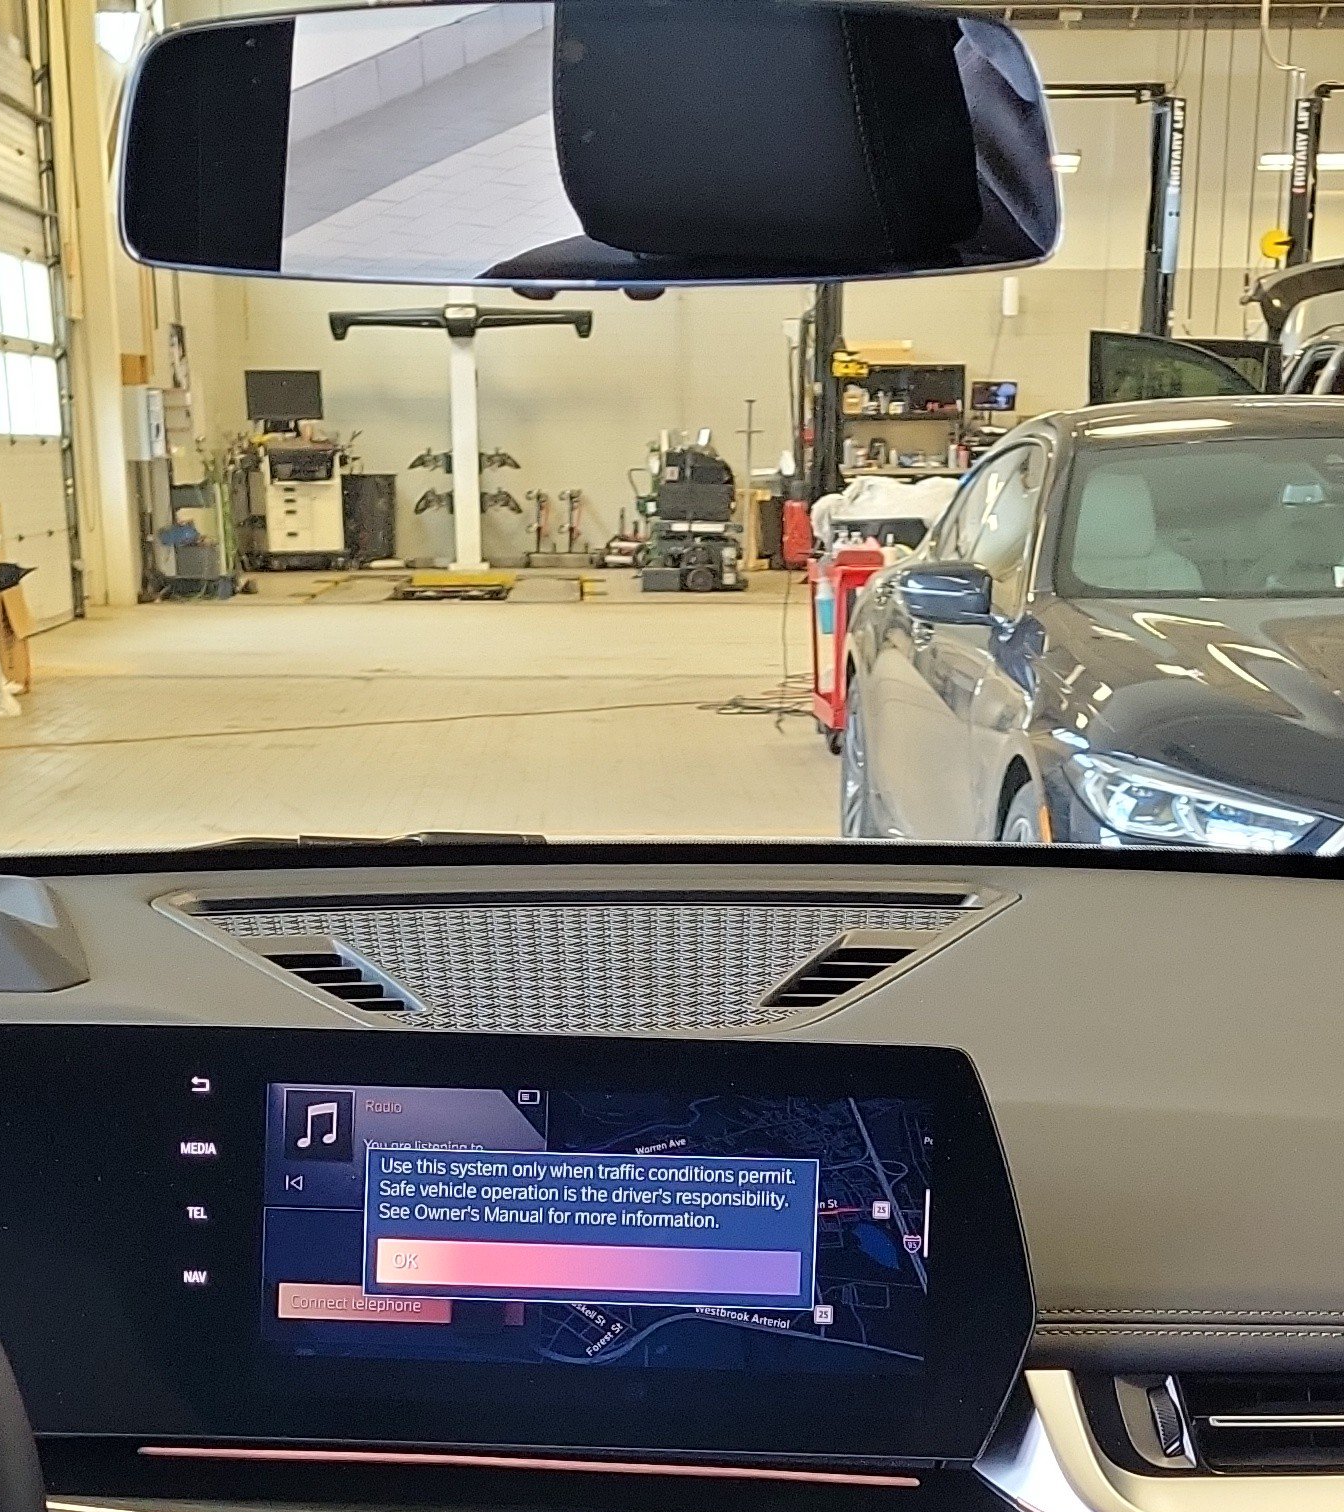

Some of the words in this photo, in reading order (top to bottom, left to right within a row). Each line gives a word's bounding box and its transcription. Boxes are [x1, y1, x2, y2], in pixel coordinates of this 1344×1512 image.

[1173, 100, 1185, 129] LIFT
[1297, 100, 1310, 129] LIFT
[1169, 131, 1183, 186] ROTARY
[1293, 132, 1308, 186] ROTARY
[365, 1100, 402, 1113] Radio
[180, 1142, 217, 1155] MEDIA
[363, 1139, 387, 1149] You
[635, 1143, 667, 1155] Warren
[669, 1137, 686, 1148] Ave
[381, 1158, 412, 1174] Use
[417, 1159, 446, 1175] this
[450, 1162, 507, 1179] system
[512, 1162, 546, 1180] only
[550, 1164, 593, 1179] when
[598, 1165, 645, 1180] traffic
[649, 1166, 734, 1183] conditions
[739, 1168, 795, 1186] permit.
[379, 1180, 415, 1197] Safe
[420, 1182, 476, 1198] vehicle
[481, 1185, 558, 1202] operation
[564, 1186, 576, 1201] is
[581, 1187, 607, 1202] the
[612, 1188, 671, 1204] driver's
[676, 1191, 789, 1210] responsibility.
[827, 1199, 838, 1208] St
[187, 1206, 207, 1219] TEL
[379, 1203, 410, 1219] See
[415, 1204, 480, 1221] Owner's
[484, 1207, 543, 1223] Manual
[548, 1208, 571, 1224] for
[575, 1213, 616, 1225] more
[621, 1210, 720, 1228] information.
[877, 1206, 886, 1214] 25
[392, 1254, 418, 1269] OK
[183, 1271, 207, 1283] NAV
[291, 1294, 347, 1311] Connect
[352, 1298, 421, 1313] telephone
[593, 1314, 606, 1327] St
[695, 1307, 750, 1322] Westbrook
[751, 1314, 790, 1329] Arterial
[818, 1310, 829, 1319] 25
[586, 1331, 613, 1357] Forest
[611, 1322, 623, 1334] St
